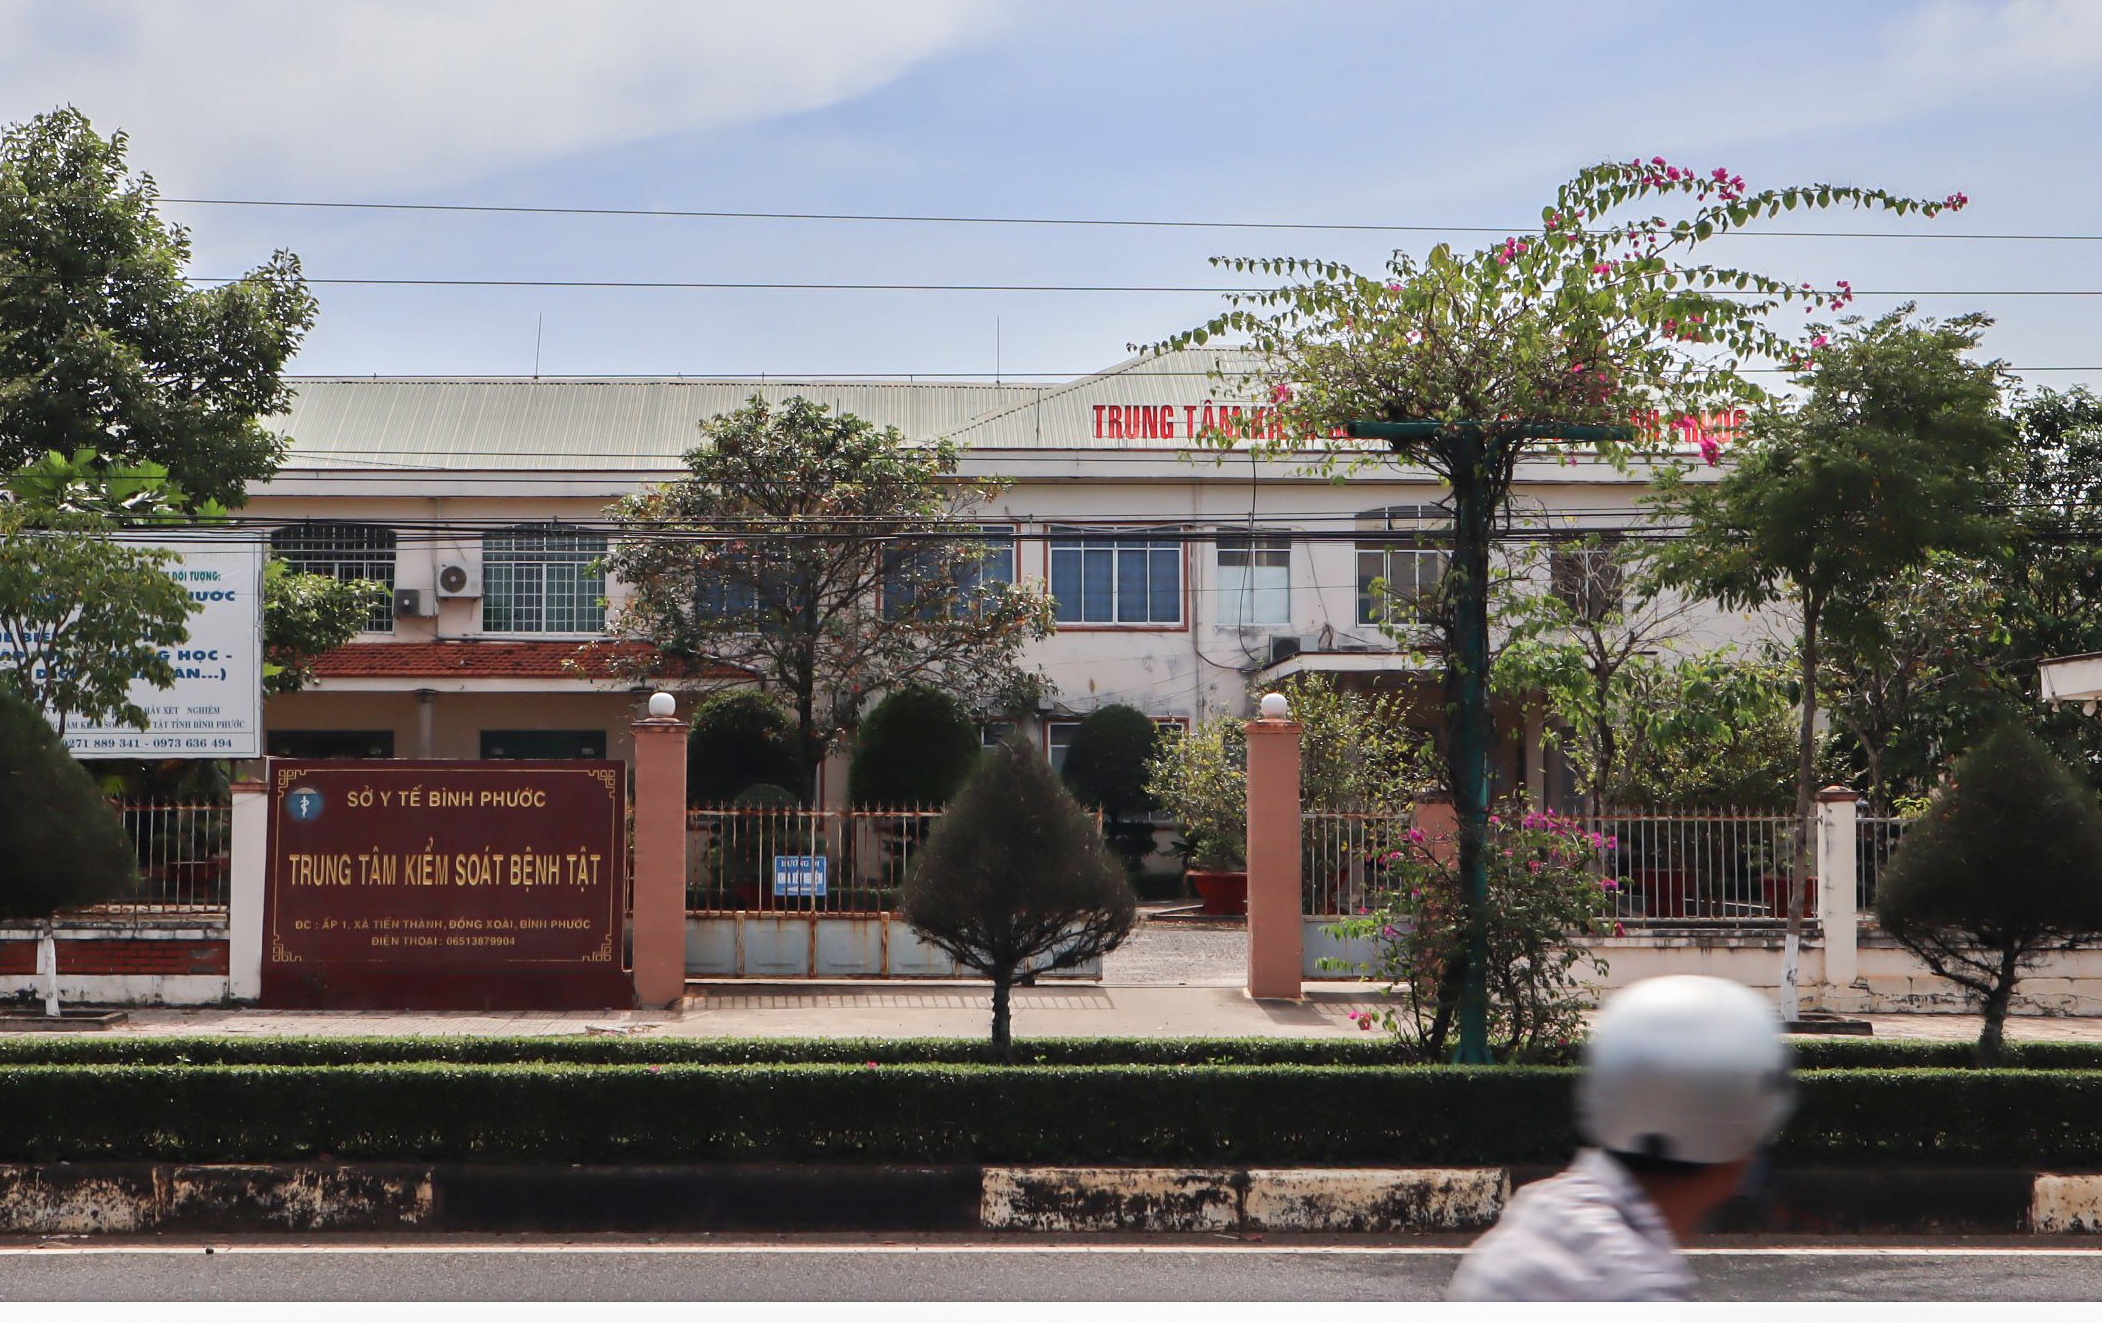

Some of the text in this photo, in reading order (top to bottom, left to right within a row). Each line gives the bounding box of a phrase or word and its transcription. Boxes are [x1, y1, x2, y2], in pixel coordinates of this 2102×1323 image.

[1093, 404, 1174, 439] TRUNG
[1184, 399, 1242, 439] TÂM
[177, 650, 218, 664] HỌC
[94, 739, 115, 748] 889
[120, 739, 140, 748] 341
[153, 738, 181, 748] 0973
[185, 738, 207, 748] 636
[211, 738, 232, 748] 494
[347, 784, 547, 808] SỞ Y TẾ BÌNH PHƯỚC
[289, 837, 601, 893] TRUNG TÂM KIỂM SOÁT BỆNH TẬT
[295, 920, 312, 930] ĐC
[354, 918, 369, 930] XÃ
[373, 916, 400, 930] TIẾN
[519, 918, 547, 930] BÌNH
[550, 917, 591, 930] PHƯỚC
[446, 937, 516, 946] 06513879904
